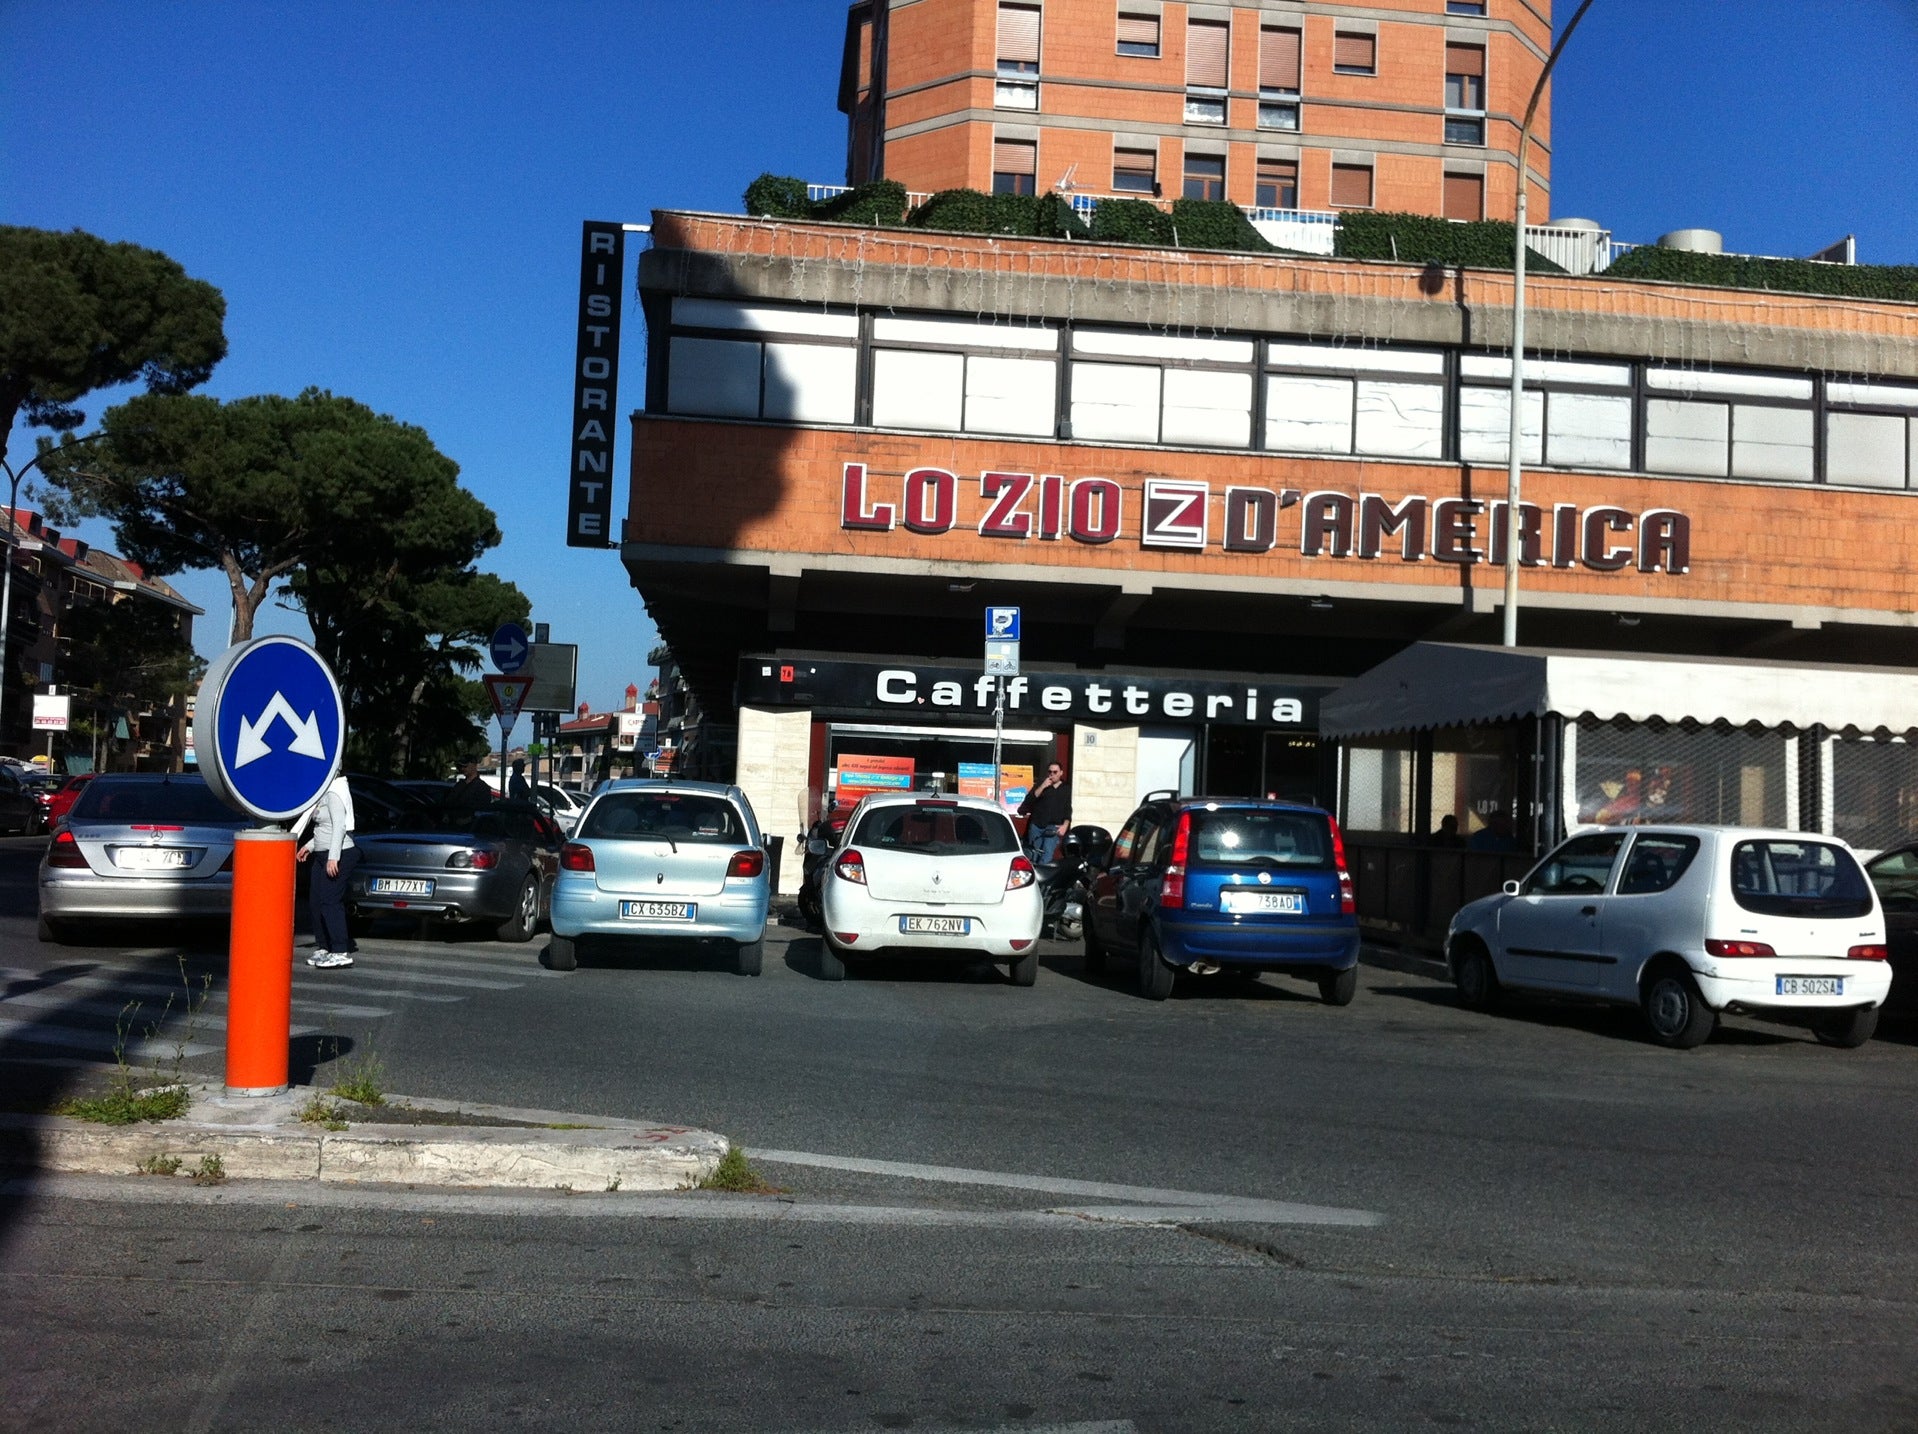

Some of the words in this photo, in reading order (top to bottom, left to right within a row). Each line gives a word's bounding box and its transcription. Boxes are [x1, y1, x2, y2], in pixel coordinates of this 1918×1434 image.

[577, 231, 616, 536] RISTORANTE
[841, 462, 957, 534] LO
[978, 470, 1122, 545] ZIO
[1223, 485, 1690, 575] D'AMERICA
[876, 669, 1302, 723] Caffetteria
[1086, 735, 1095, 744] 10
[378, 879, 391, 890] BM
[395, 880, 425, 891] 177XY
[1259, 895, 1293, 909] 738AD
[631, 903, 645, 914] CX
[649, 904, 686, 916] 635BZ
[908, 917, 922, 930] EK
[927, 918, 962, 931] 762NV
[1783, 980, 1798, 993] CB
[1802, 980, 1836, 994] 502SA
